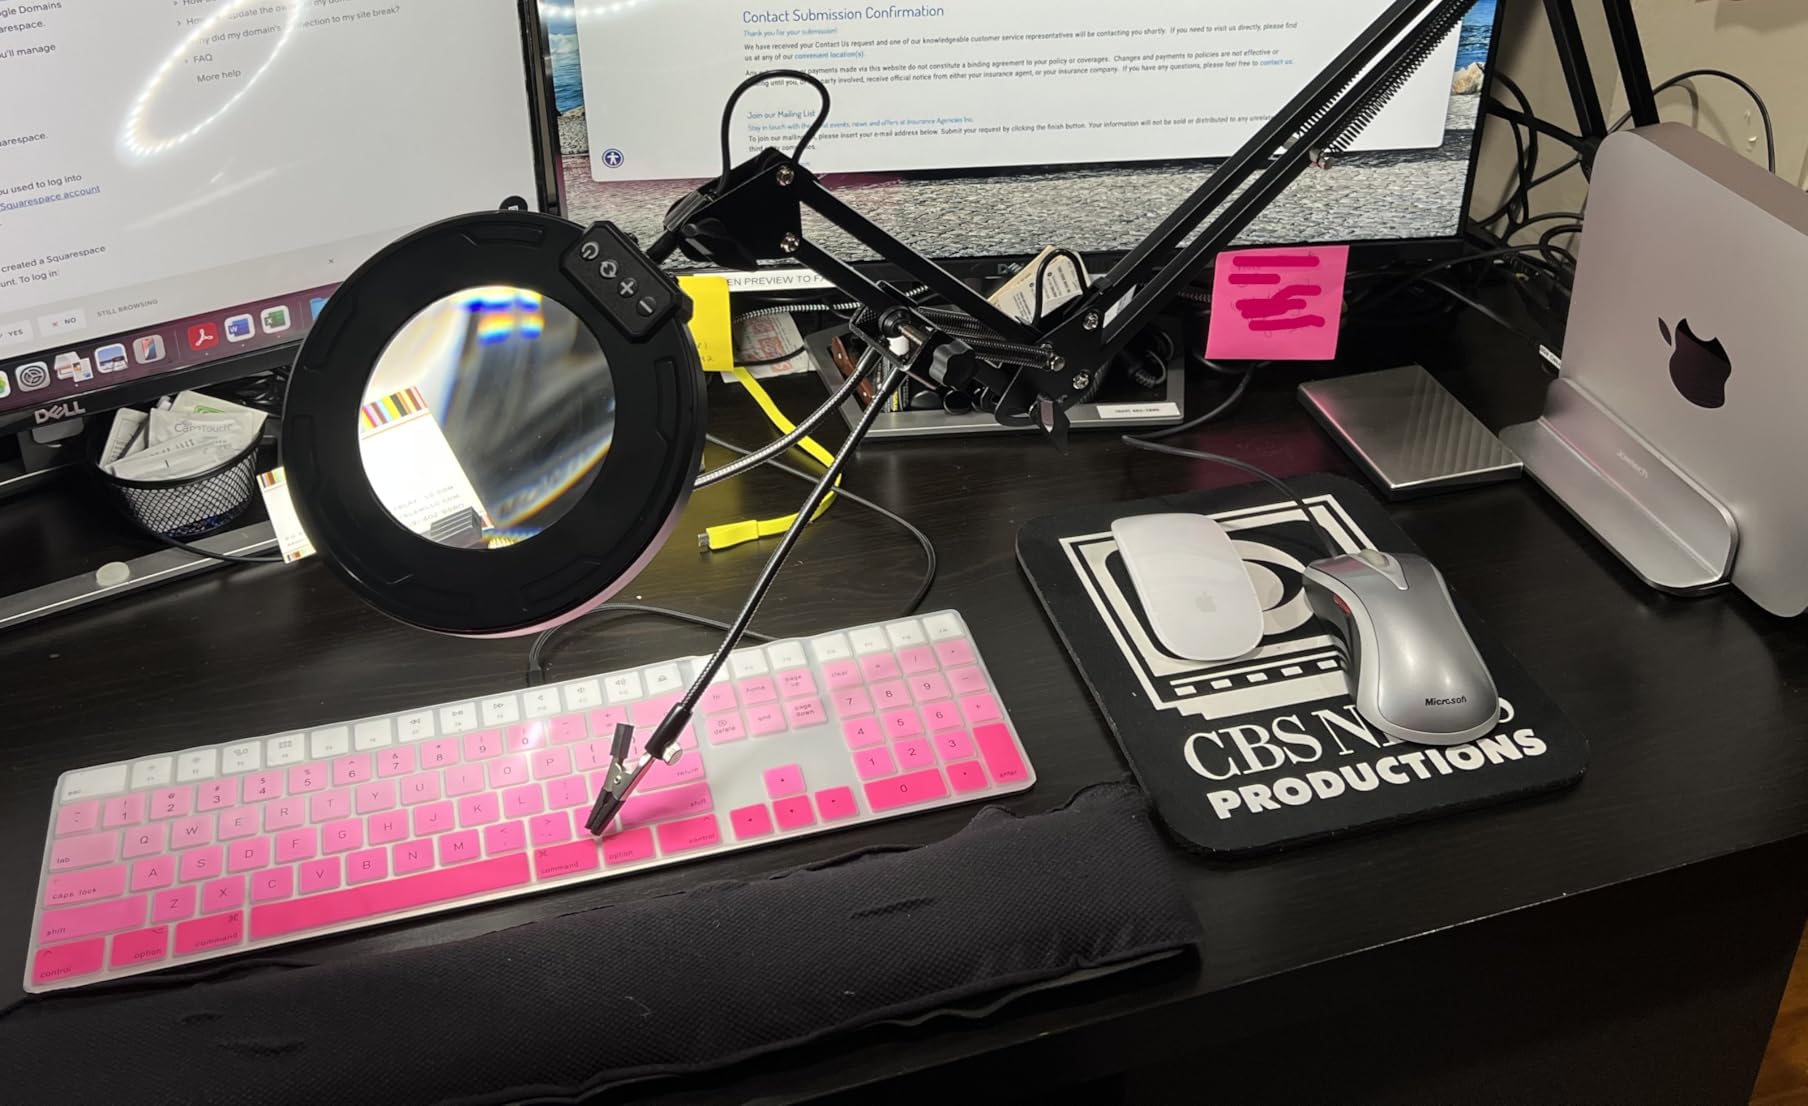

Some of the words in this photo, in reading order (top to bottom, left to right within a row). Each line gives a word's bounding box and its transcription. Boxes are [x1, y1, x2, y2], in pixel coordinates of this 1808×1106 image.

[18, 2, 62, 14] Domains
[259, 6, 274, 15] the
[342, 15, 354, 23] my
[356, 11, 371, 20] site
[372, 6, 400, 17] break?
[743, 10, 790, 23] Contact
[793, 8, 862, 21] Submission
[866, 5, 944, 19] Confirmation
[212, 33, 225, 42] did
[242, 25, 281, 37] domain's
[851, 40, 874, 48] request
[923, 35, 969, 45] knowledgeable
[971, 34, 1000, 42] customer
[1002, 33, 1024, 41] service
[1025, 31, 1073, 41] representatives
[1075, 30, 1086, 38] will
[1096, 28, 1129, 38] contacting
[1214, 24, 1227, 32] visit
[1263, 21, 1284, 31] please
[1286, 21, 1297, 29] find
[17, 44, 56, 57] manage
[795, 51, 829, 60] convenient
[193, 53, 213, 64] FAQ
[808, 67, 838, 75] payments
[883, 64, 906, 72] website
[929, 62, 960, 70] constitute
[967, 61, 990, 70] binding
[992, 60, 1025, 68] agreement
[1049, 57, 1067, 66] policy
[1113, 54, 1140, 63] Changes
[1142, 53, 1154, 61] and
[1155, 52, 1185, 61] payments
[1195, 50, 1219, 60] policies
[1244, 48, 1270, 56] effective
[197, 72, 220, 83] More
[222, 69, 241, 79] help
[747, 111, 763, 120] Join
[778, 110, 802, 120] Mailing
[803, 109, 816, 118] List
[819, 132, 839, 140] please
[841, 131, 857, 139] insert
[859, 132, 872, 140] your
[894, 129, 918, 137] address
[941, 127, 962, 135] Submit
[964, 128, 977, 136] your
[978, 126, 1001, 135] request
[1089, 121, 1102, 129] Your
[1104, 120, 1139, 128] information
[11, 182, 34, 193] used
[36, 181, 46, 189] to
[48, 175, 63, 187] log
[64, 173, 82, 184] into
[63, 185, 101, 199] account
[1, 258, 37, 273] created
[47, 245, 106, 264] Squarespace
[19, 275, 30, 285] To
[32, 271, 47, 283] log
[744, 276, 794, 286] PREVIEW
[796, 275, 811, 284] TO
[97, 308, 117, 319] STILL
[118, 299, 158, 313] BROWSING
[64, 317, 77, 325] NO
[8, 328, 23, 337] YES
[34, 401, 86, 424] DELL
[1183, 714, 1323, 782] CBS
[1206, 728, 1547, 820] PRODUCTIONS
